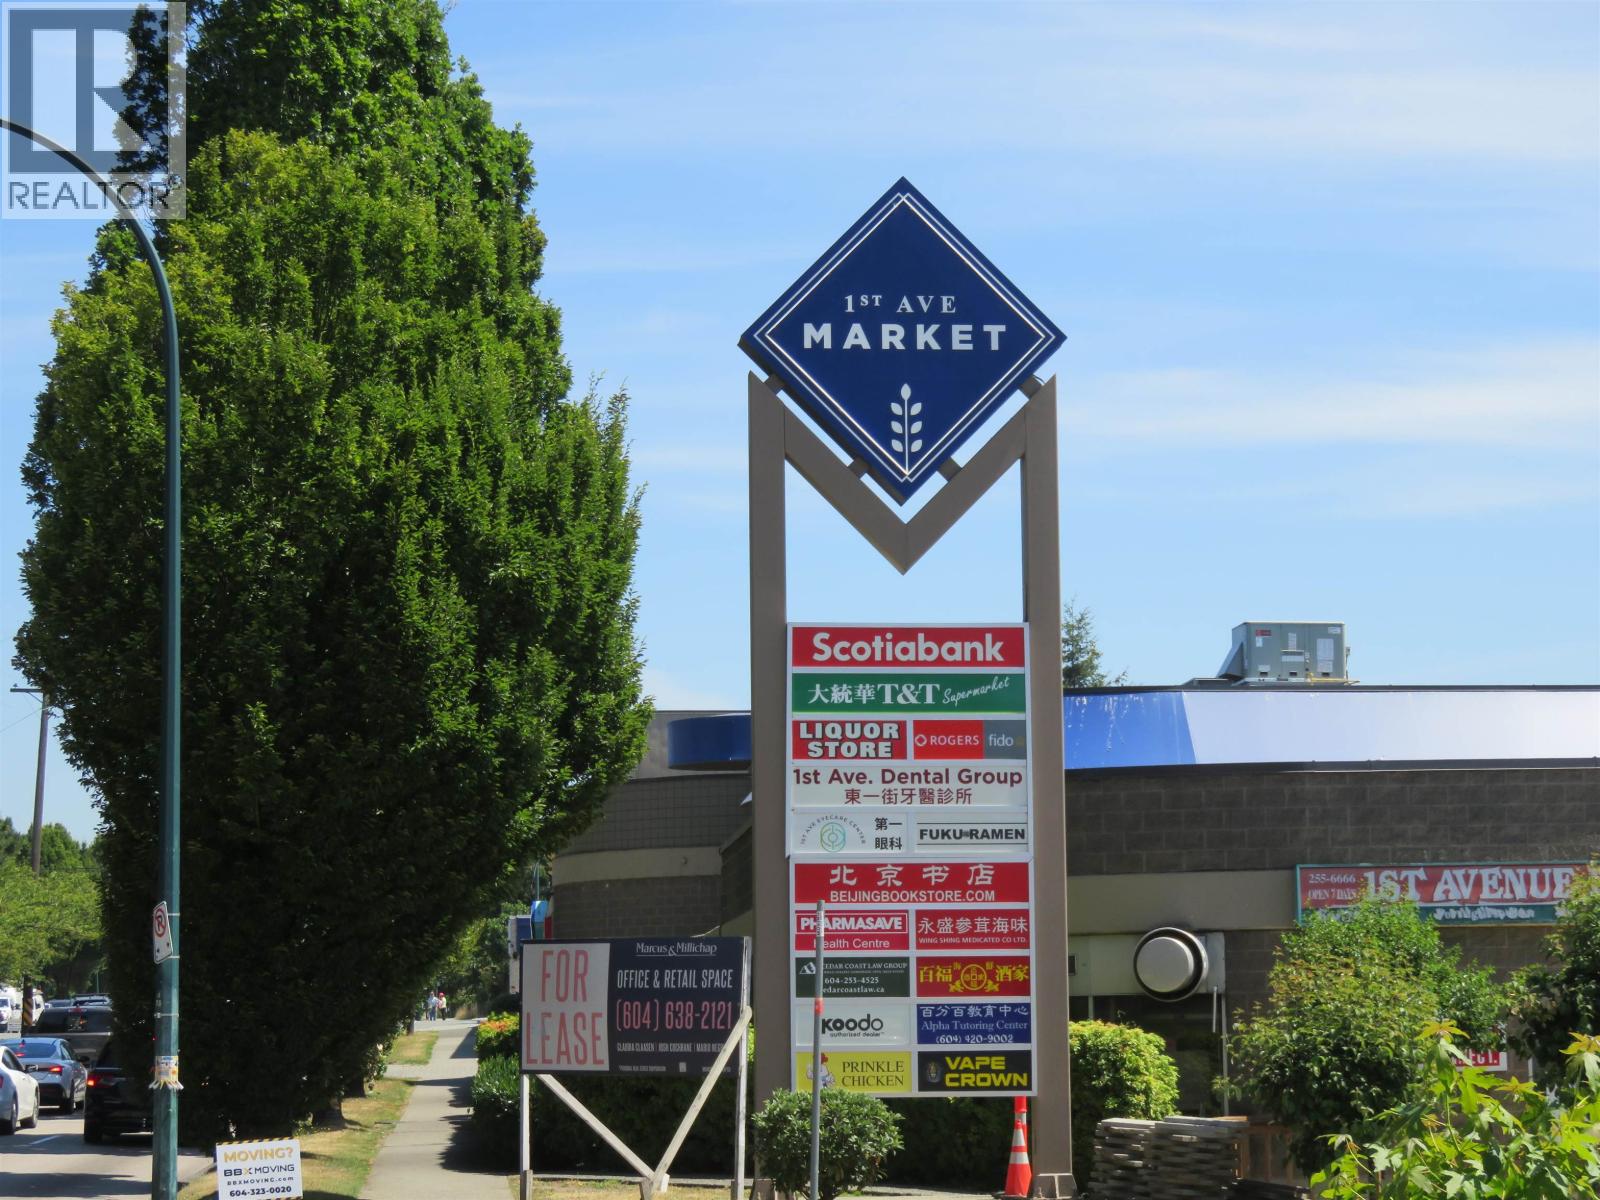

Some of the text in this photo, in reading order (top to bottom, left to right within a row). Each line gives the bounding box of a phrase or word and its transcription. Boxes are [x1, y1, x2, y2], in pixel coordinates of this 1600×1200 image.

[844, 294, 956, 313] 1ST AVE
[803, 323, 1006, 351] MARKET
[812, 632, 1004, 662] Scotiabank
[877, 683, 940, 705] T&T
[943, 676, 1010, 706] Supermarket
[800, 722, 899, 740] LIQUOR
[930, 735, 979, 746] ROGERS
[988, 733, 1014, 747] fido
[807, 741, 892, 758] STORE
[793, 768, 1023, 787] 1st Ave. Dental Group
[844, 788, 973, 805] 東一街牙醫診所
[874, 817, 903, 831] 第一
[919, 828, 1025, 840] FUKU RAMEN
[874, 837, 903, 850] 眼科
[829, 864, 995, 886] 北京书店
[1433, 867, 1574, 901] AVENUE
[830, 890, 995, 902] BEIJINGBOOKSTORE.COM
[636, 942, 668, 953] Marcus
[676, 942, 718, 956] Millichap
[814, 938, 890, 949] ealth Centre
[541, 949, 589, 1002] FOR
[617, 968, 734, 989] OFFICE & RETAIL SPACE
[616, 999, 732, 1032] (604) 638-2121
[919, 1004, 1029, 1018] 百分百教育中心
[821, 1013, 883, 1034] koodo
[921, 1020, 1028, 1032] Alpha Tutoring Center
[526, 1011, 605, 1066] LEASE
[935, 1034, 1014, 1044] (604) 420-9002
[842, 1060, 904, 1073] PRINKLE
[945, 1056, 1006, 1070] VAPE
[842, 1075, 904, 1087] CHICKEN
[945, 1073, 1028, 1087] CROWN
[223, 1147, 294, 1163] MOVING?
[254, 1164, 295, 1174] MOVING
[229, 1186, 292, 1197] 604-323-0020
